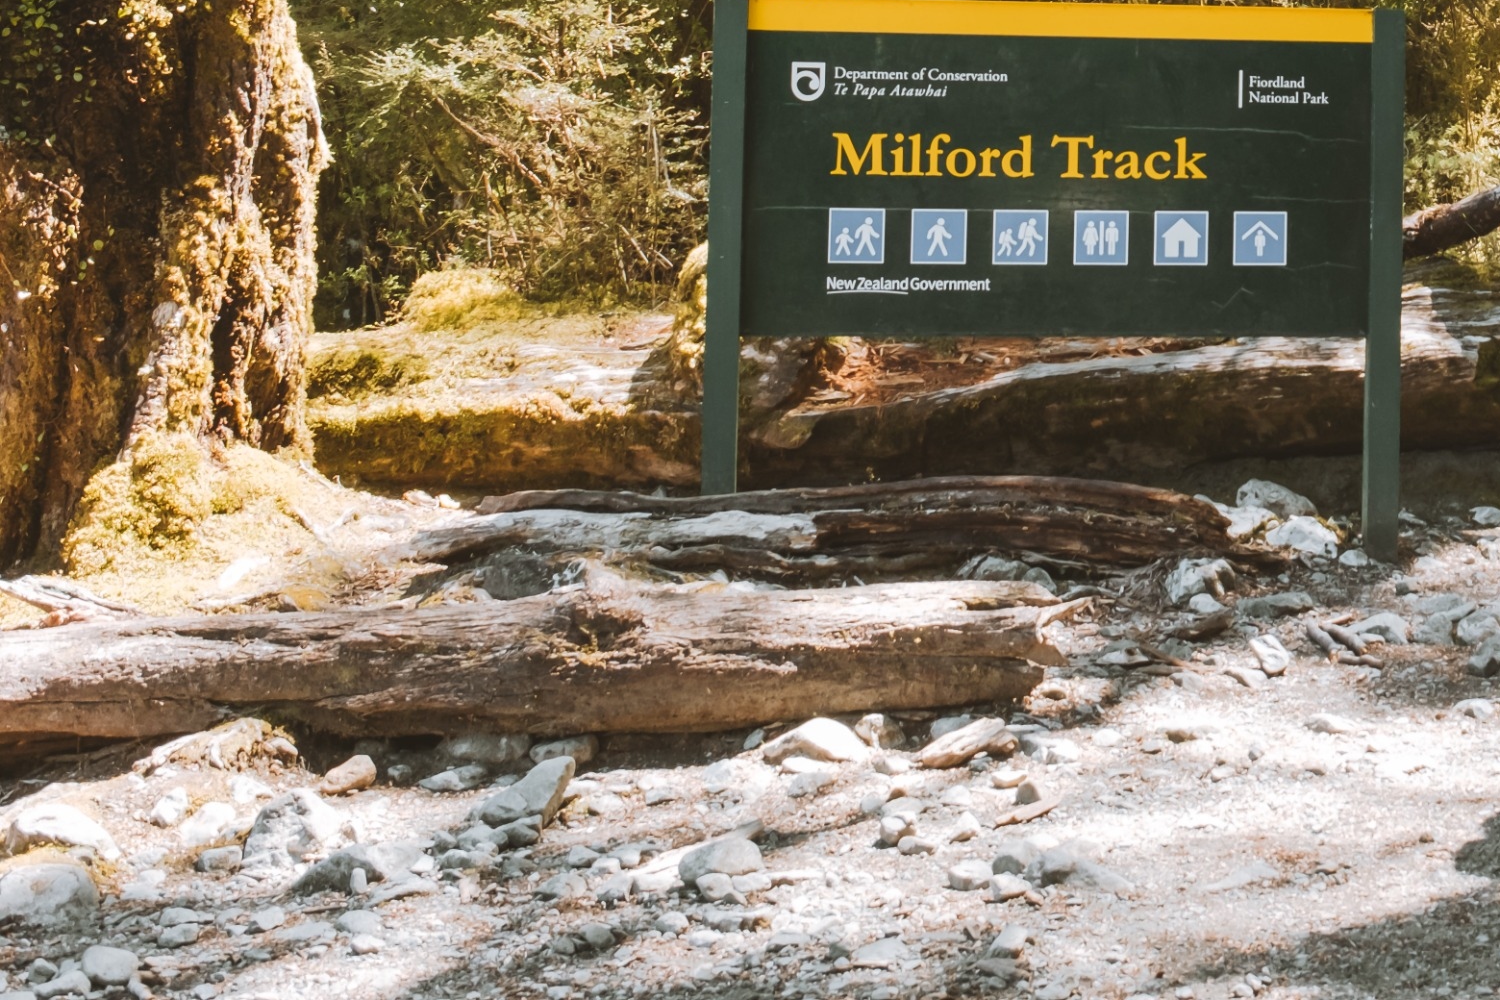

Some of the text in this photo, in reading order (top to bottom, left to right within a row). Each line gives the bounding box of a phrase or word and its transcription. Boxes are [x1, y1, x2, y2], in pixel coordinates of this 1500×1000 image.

[834, 66, 1008, 82] Department of Conservation
[1249, 75, 1305, 89] Fiordland
[834, 82, 948, 100] Te Papa Atawhai
[1248, 90, 1329, 105] National Park
[829, 132, 1208, 180] Milford Track
[826, 276, 991, 292] New Zealand Government
